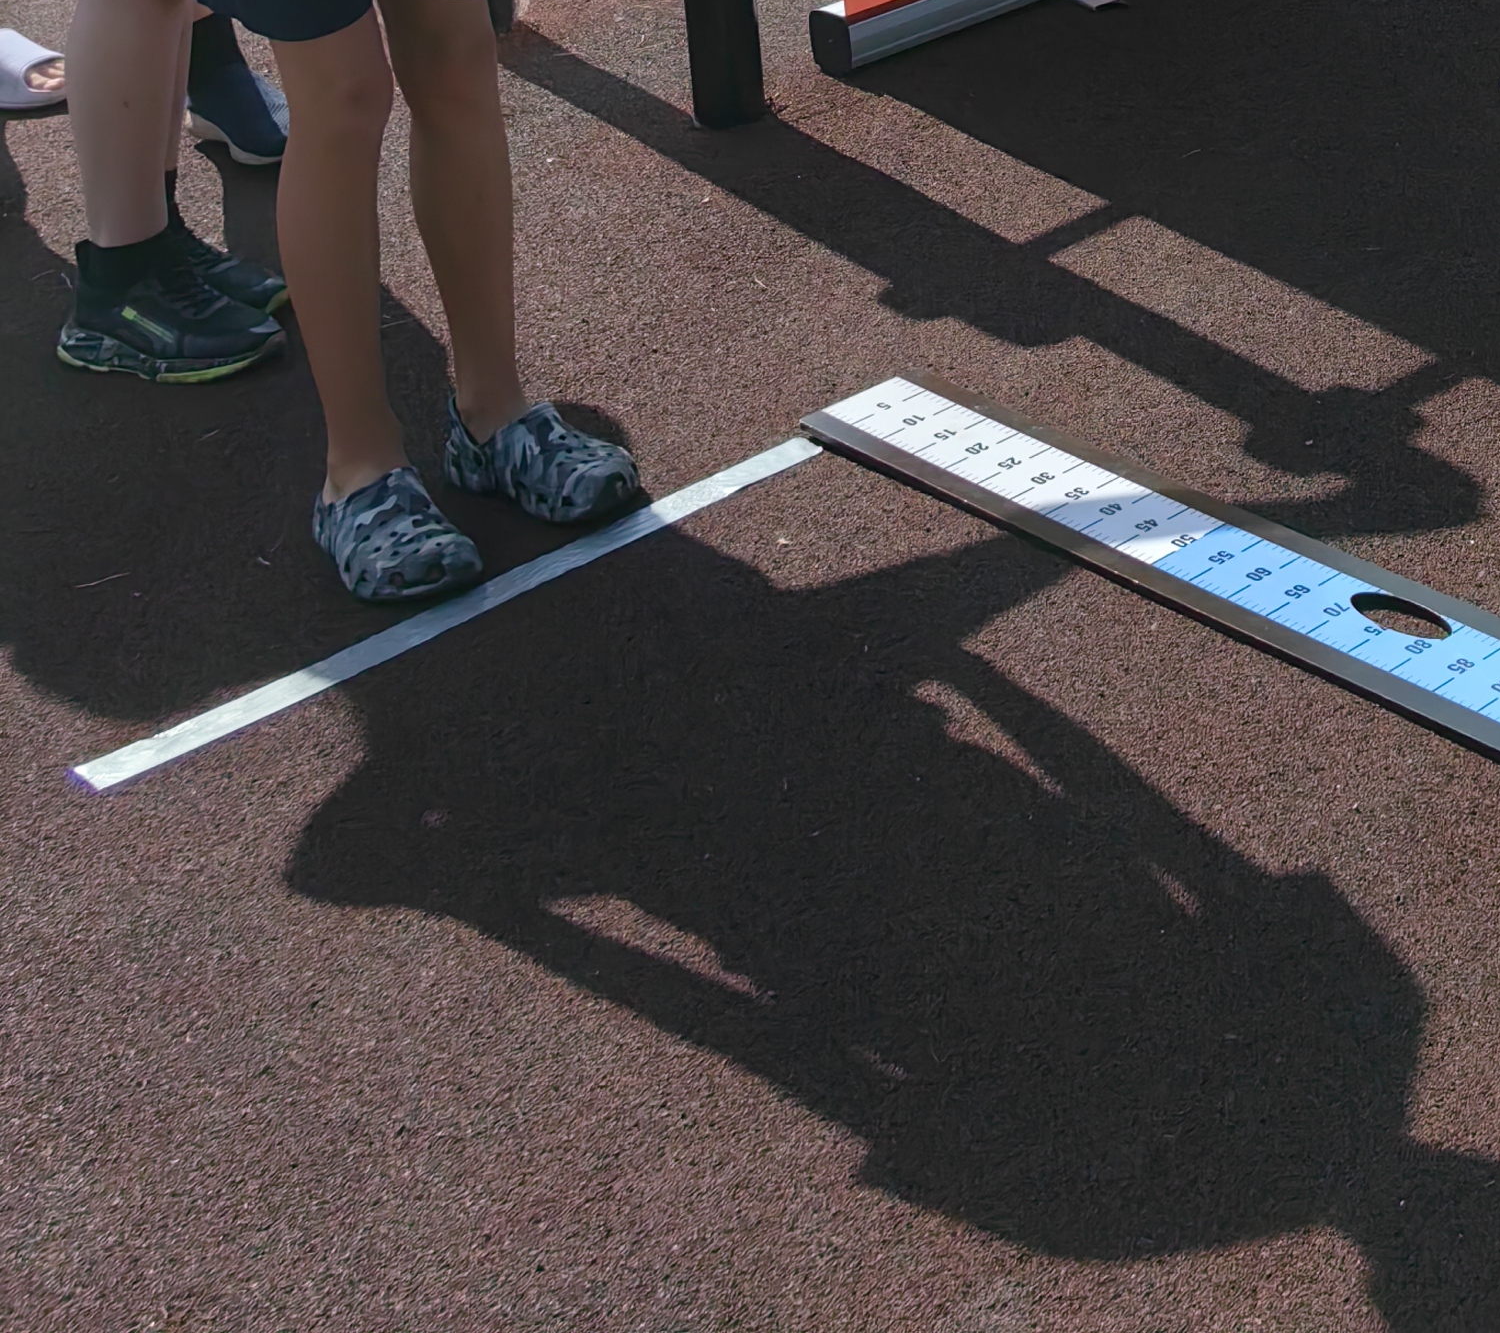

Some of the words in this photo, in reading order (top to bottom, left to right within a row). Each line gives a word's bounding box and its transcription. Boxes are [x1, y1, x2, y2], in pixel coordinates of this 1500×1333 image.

[877, 402, 892, 411] 5
[902, 414, 925, 427] 10
[934, 428, 957, 441] 15
[964, 442, 989, 455] 20
[997, 456, 1022, 470] 25
[1030, 471, 1055, 485] 30
[1064, 487, 1089, 500] 35
[1099, 502, 1123, 516] 40
[1134, 518, 1159, 532] 45
[1170, 534, 1197, 547] 50
[1208, 550, 1235, 565] 55
[1245, 567, 1272, 581] 60
[1284, 584, 1311, 599] 65
[1323, 602, 1350, 617] 70
[1404, 639, 1433, 654] 80
[1447, 658, 1475, 674] 85
